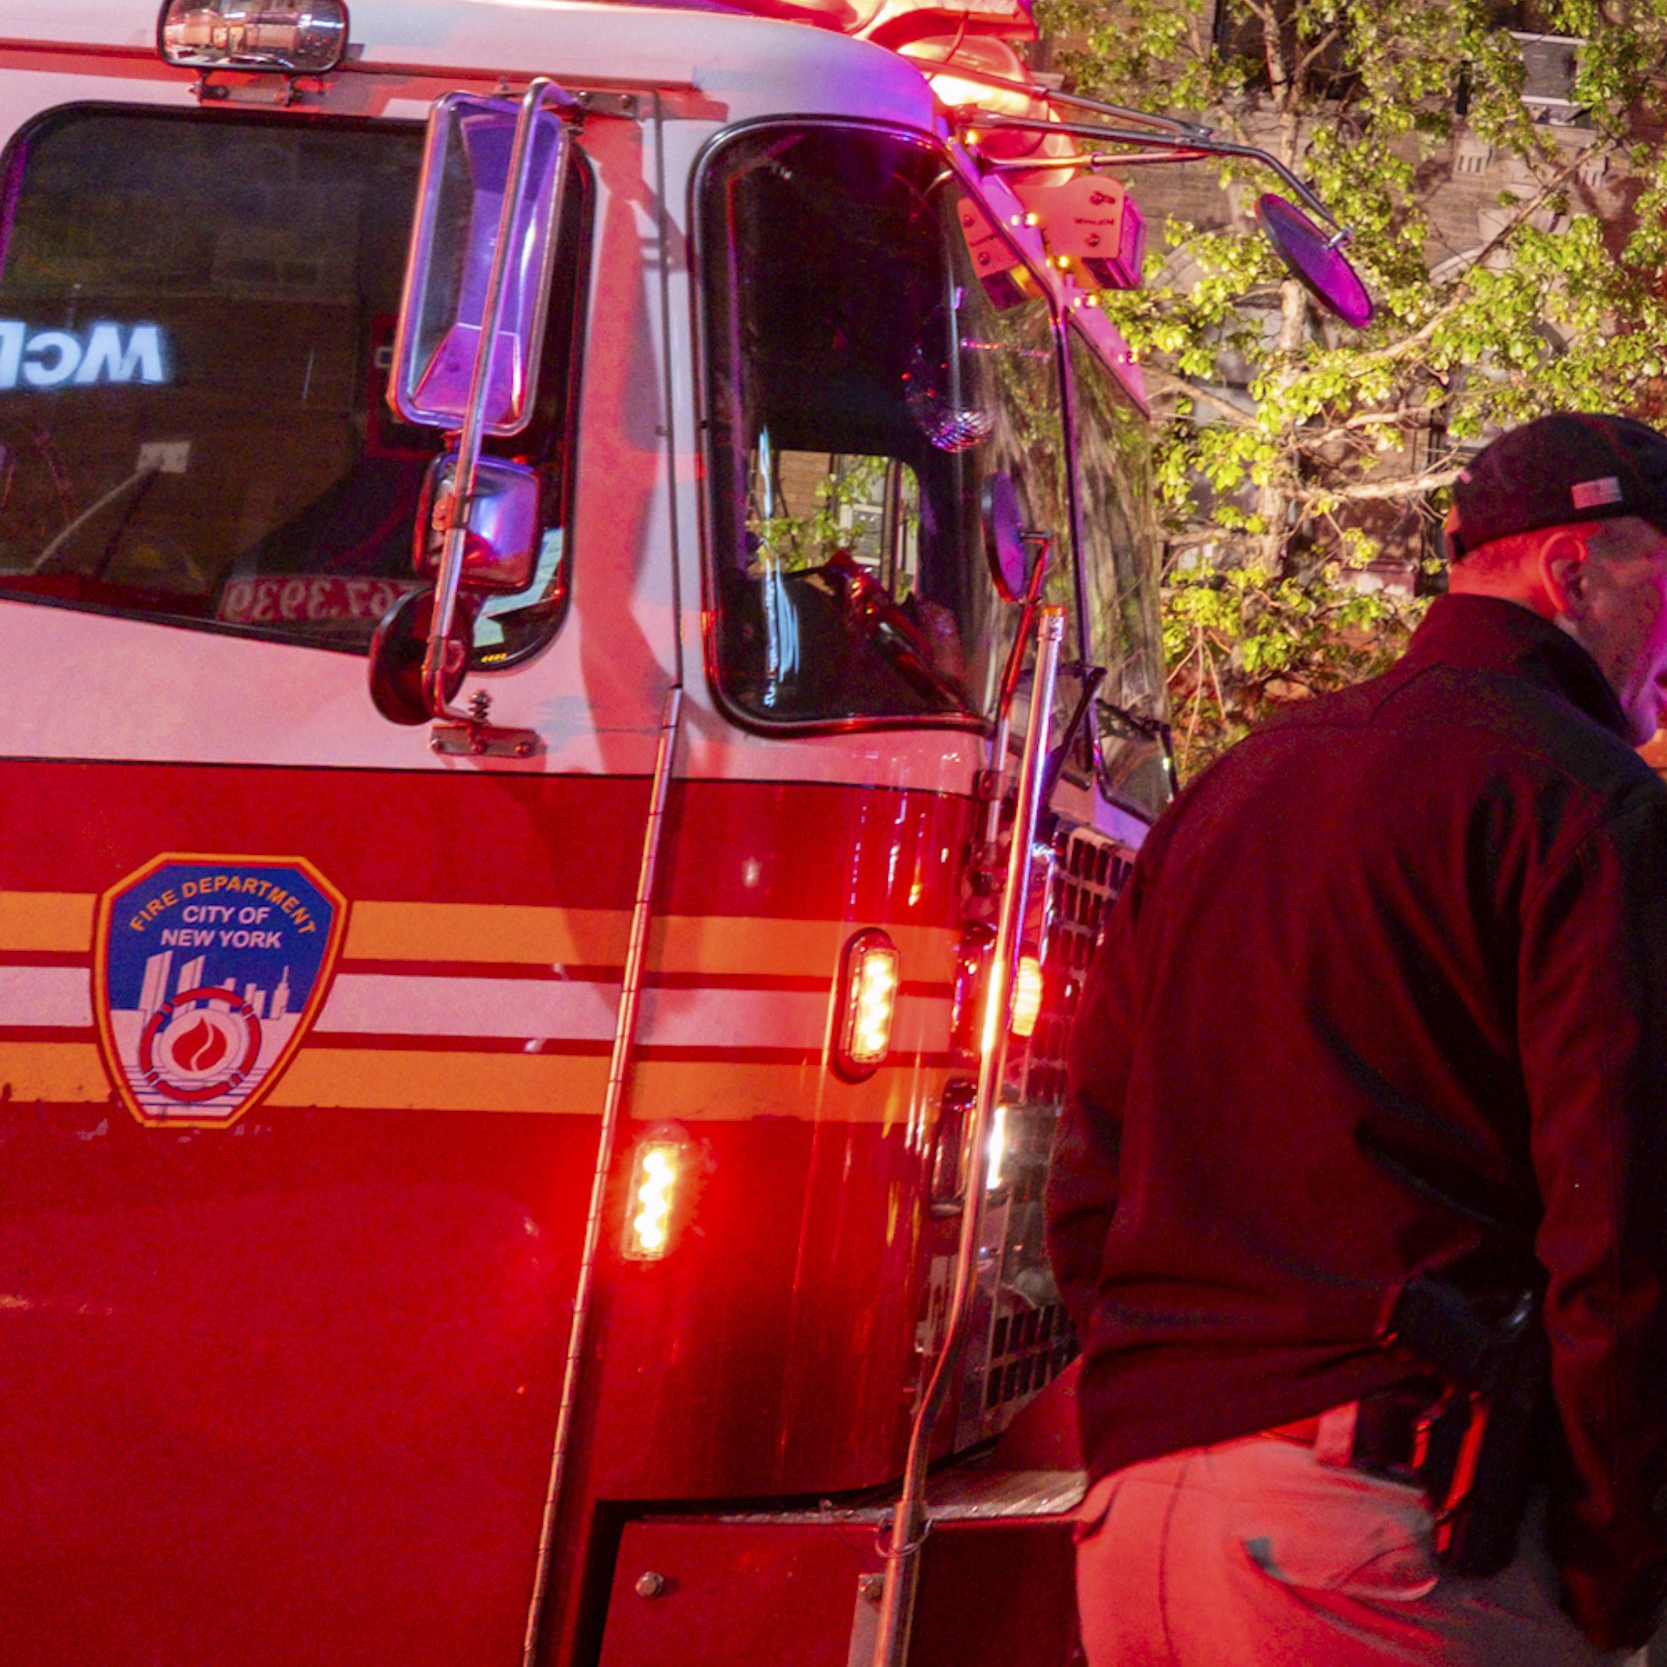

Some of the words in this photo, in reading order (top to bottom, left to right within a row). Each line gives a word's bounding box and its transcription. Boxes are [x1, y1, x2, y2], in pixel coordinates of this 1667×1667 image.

[130, 890, 178, 932] FIRE
[182, 875, 316, 935] DEPARTMENT
[182, 905, 235, 924] CITY
[238, 906, 271, 925] OF
[160, 929, 215, 947] NEW
[219, 930, 282, 949] YORK
